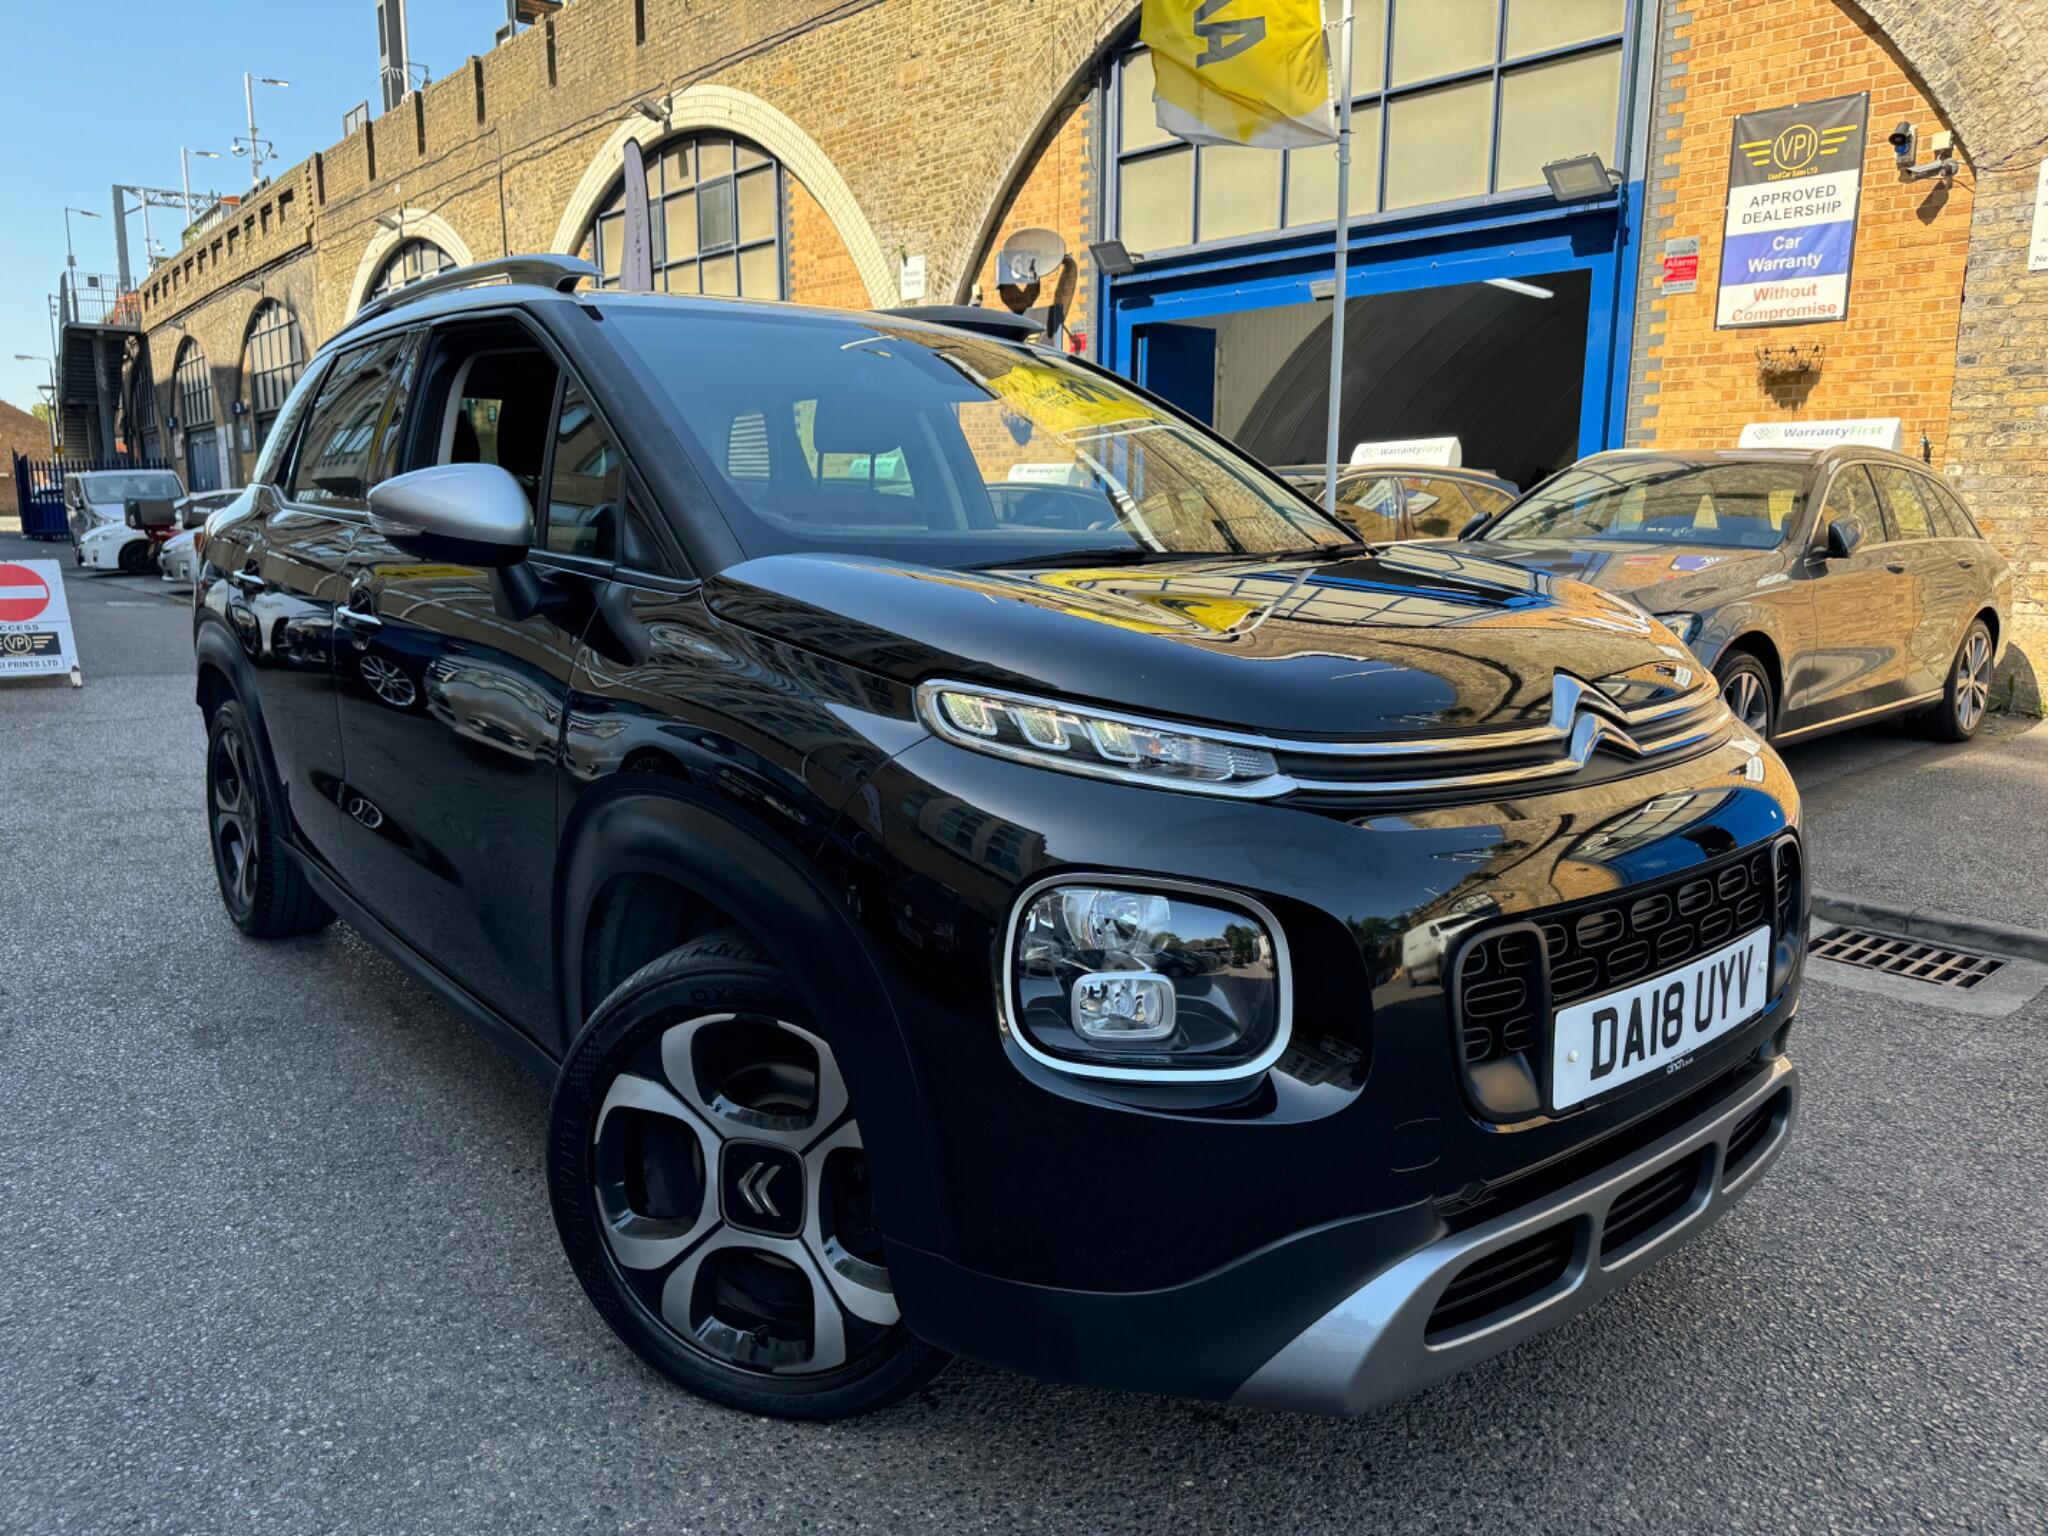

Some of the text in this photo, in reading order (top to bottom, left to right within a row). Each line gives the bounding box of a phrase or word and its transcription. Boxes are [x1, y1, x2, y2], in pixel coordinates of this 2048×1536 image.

[1780, 132, 1812, 162] VPI
[1749, 184, 1837, 208] APPROVED
[1742, 200, 1842, 225] DEALERSHIP
[1772, 236, 1803, 251] Car
[1665, 258, 1696, 268] Alarm
[1747, 252, 1823, 273] Warranty
[1753, 283, 1818, 302] Without
[1732, 301, 1838, 322] Compromise
[1783, 425, 1884, 438] WarrantyFirst
[8, 660, 40, 669] PRINTS
[42, 659, 58, 667] LTD
[1590, 945, 1754, 1081] DA18 UYV
